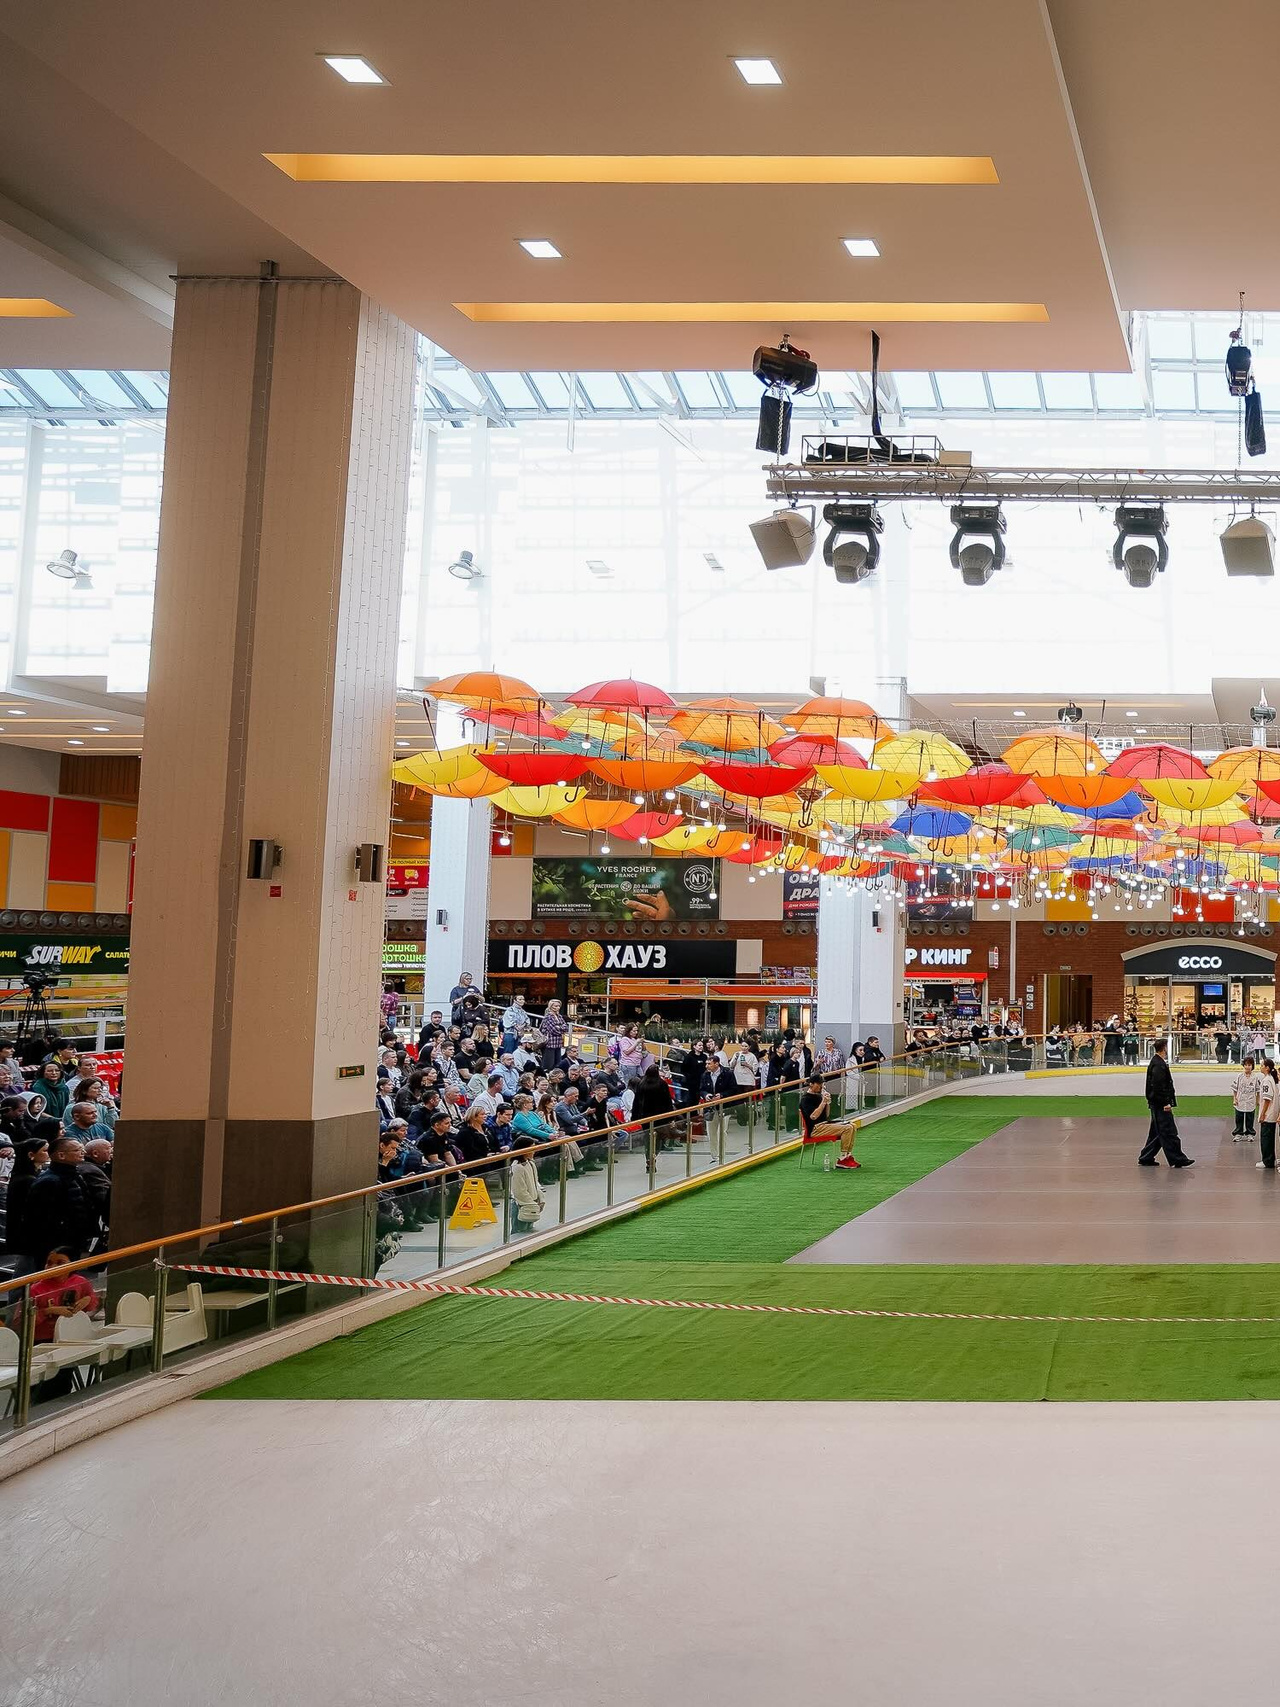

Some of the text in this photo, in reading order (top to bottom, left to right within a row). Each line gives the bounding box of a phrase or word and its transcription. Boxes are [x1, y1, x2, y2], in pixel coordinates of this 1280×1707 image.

[26, 944, 101, 964] SUBWAY
[508, 945, 667, 968] ПЛОВ ХАУЗ
[921, 948, 972, 965] КИНГ
[1178, 956, 1222, 969] ecco
